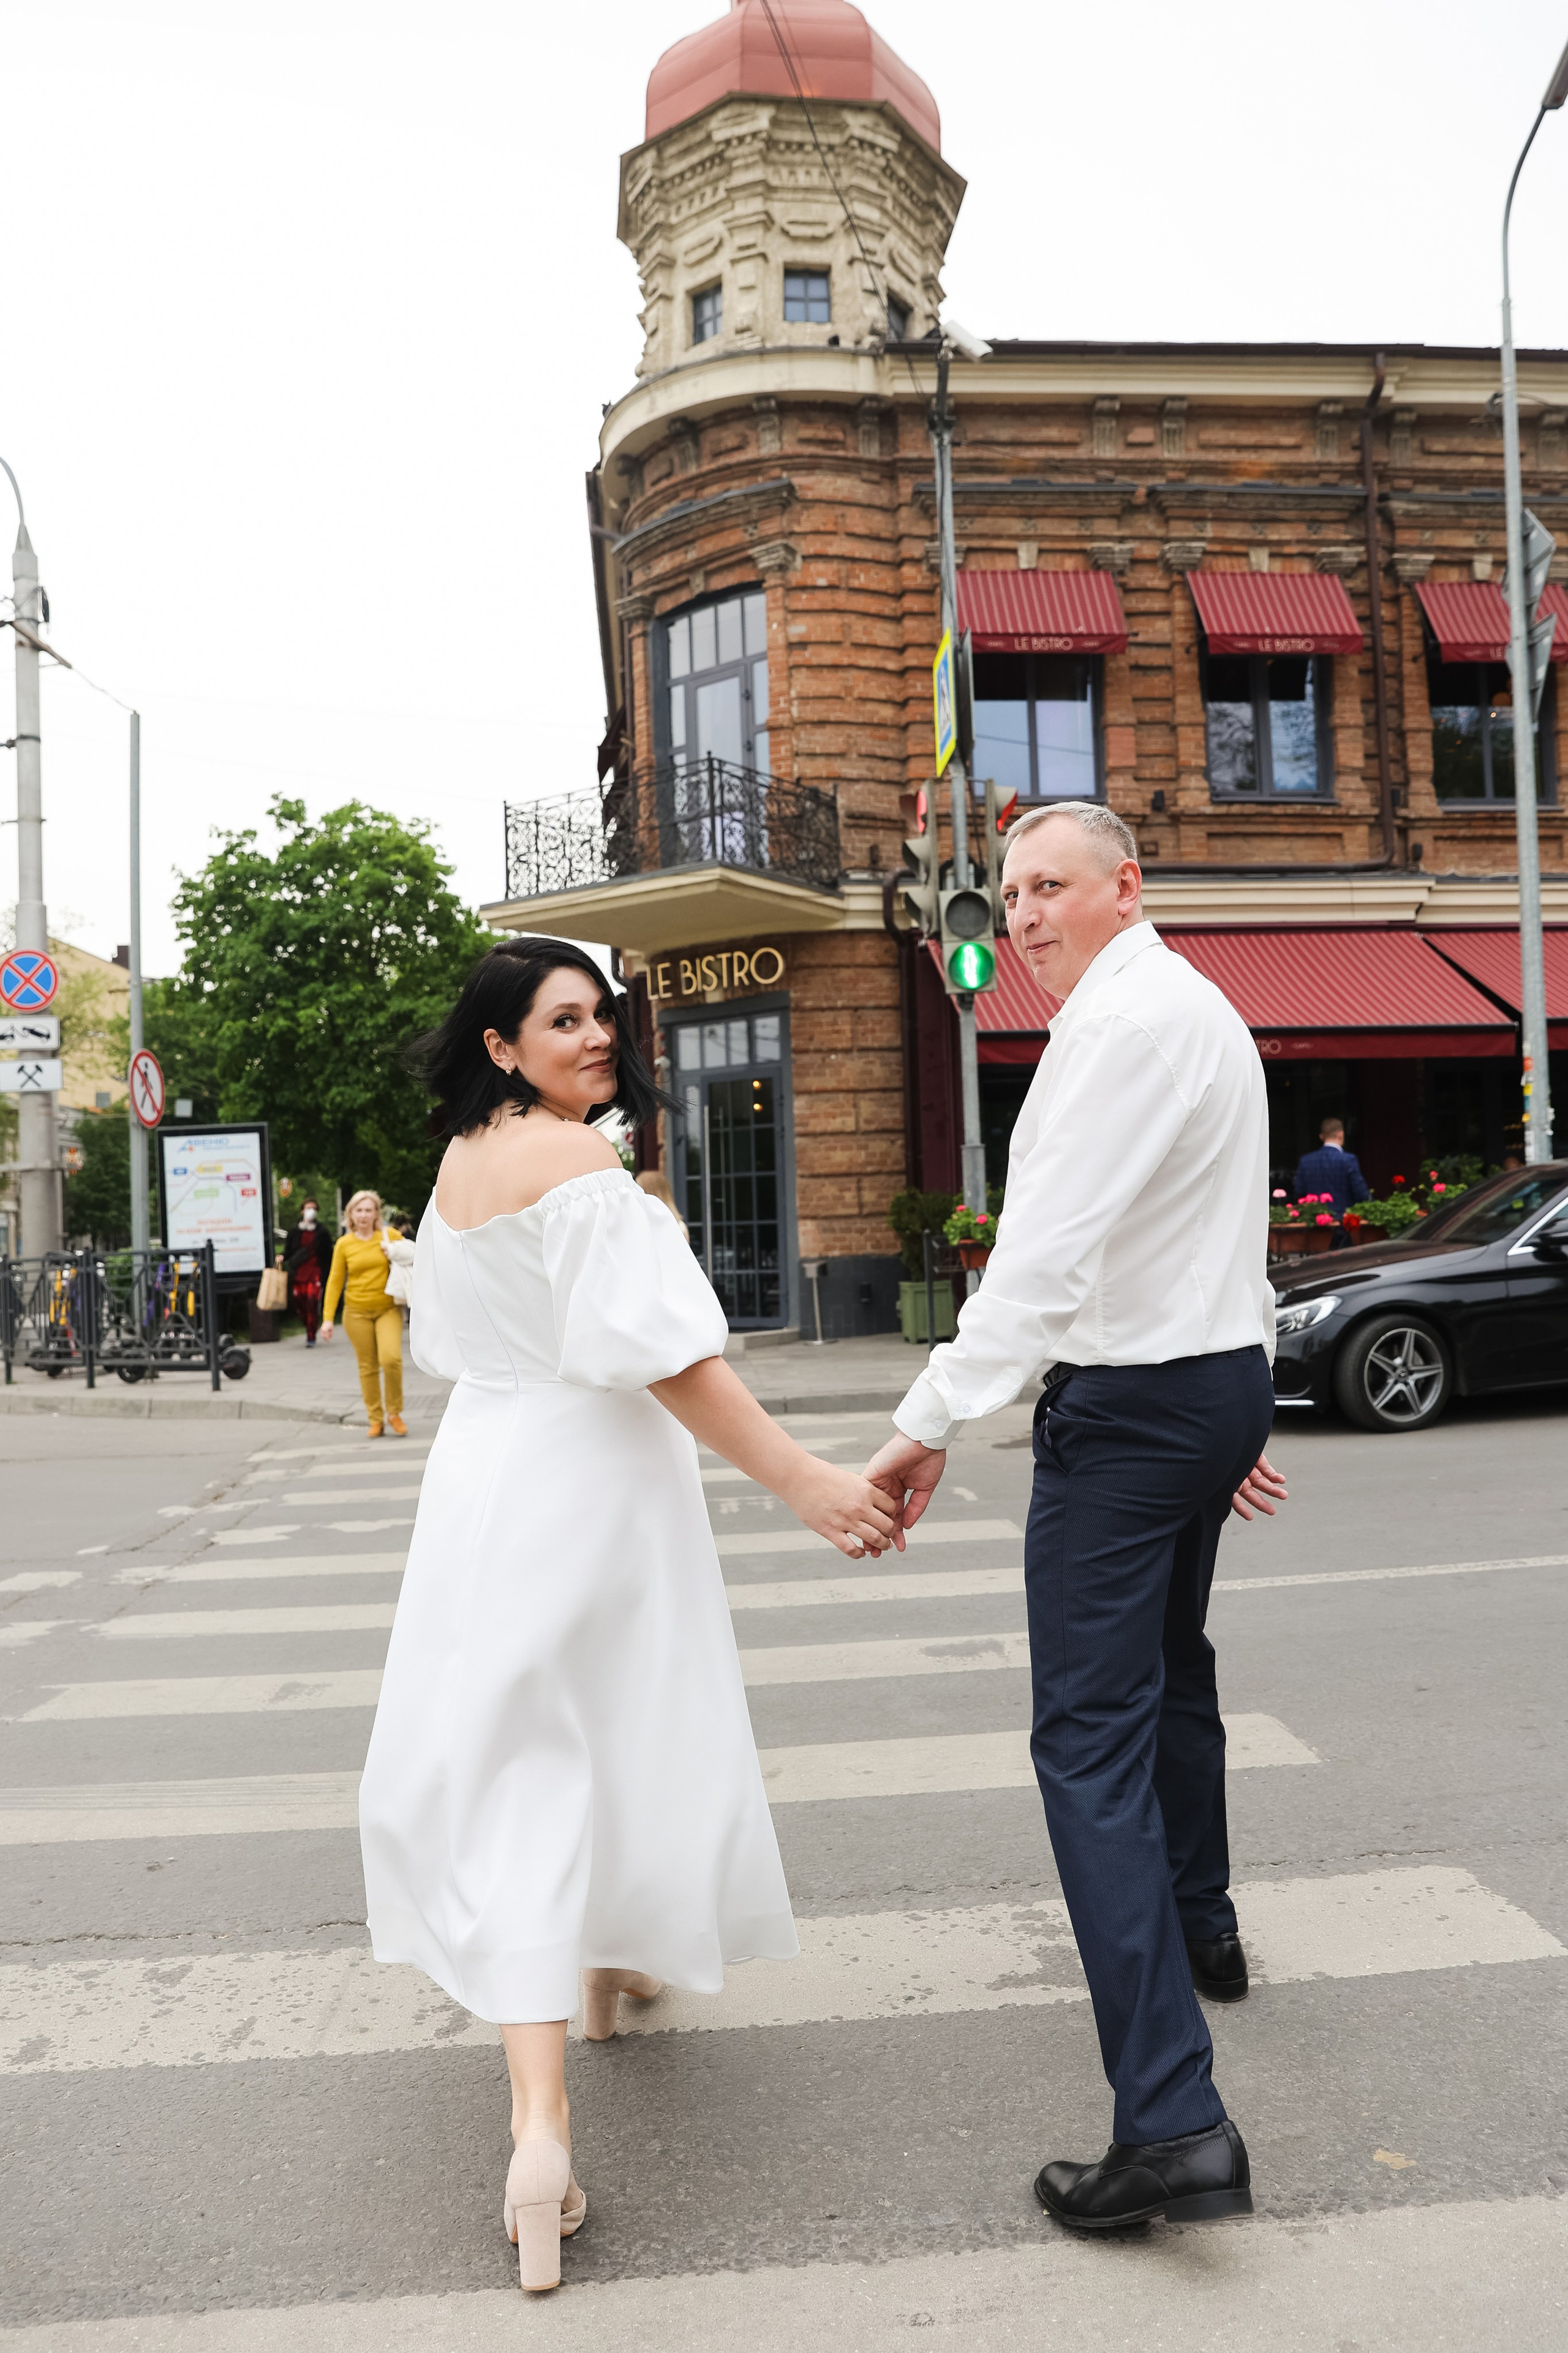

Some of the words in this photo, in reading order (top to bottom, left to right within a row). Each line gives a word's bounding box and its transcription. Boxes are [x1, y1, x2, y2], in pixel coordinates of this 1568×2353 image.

[1014, 636, 1030, 651] LE
[1031, 636, 1074, 651] BISTRO
[1257, 638, 1273, 652] LE
[1274, 638, 1315, 652] BISTRO
[1489, 646, 1505, 660] LE
[646, 962, 673, 1001] LE
[679, 947, 784, 995] BISTRO
[1254, 1039, 1282, 1054] TRO
